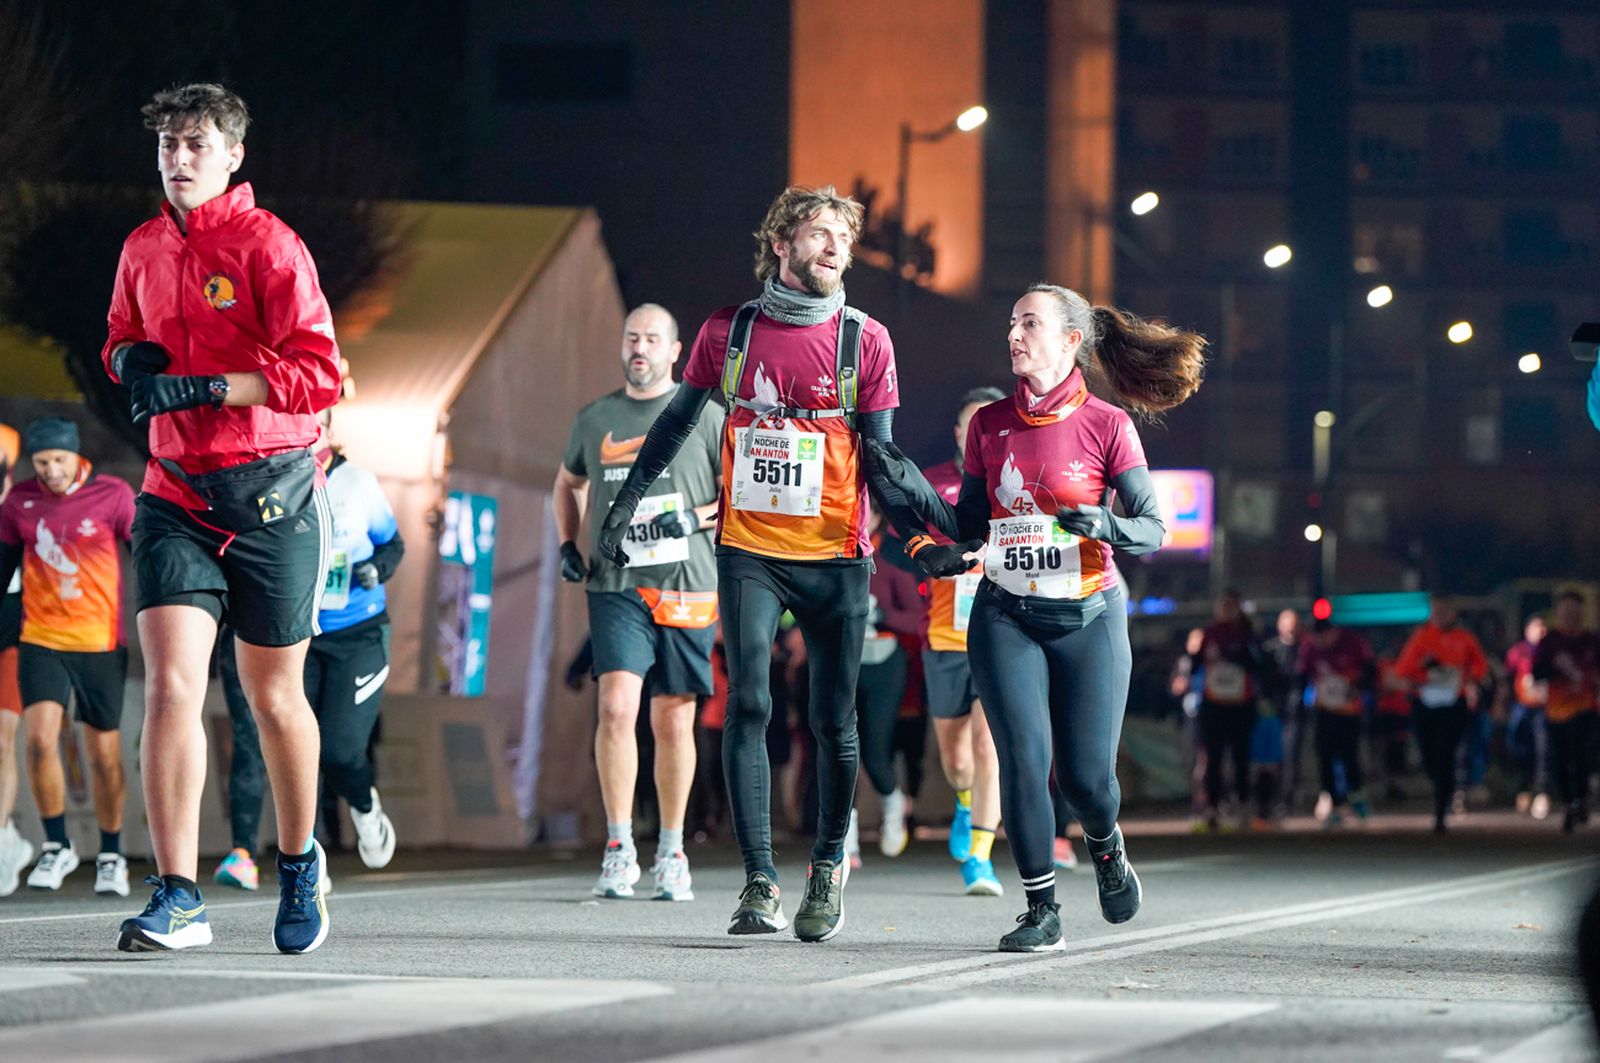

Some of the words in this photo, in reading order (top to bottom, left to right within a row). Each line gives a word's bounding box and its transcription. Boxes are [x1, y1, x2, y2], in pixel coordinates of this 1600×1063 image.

[754, 438, 779, 448] NOCHE
[780, 440, 790, 449] DE
[750, 447, 762, 457] AN
[603, 467, 630, 482] JUST
[753, 458, 802, 486] 5511
[1011, 497, 1034, 515] 43
[626, 522, 670, 543] 430
[1008, 524, 1032, 535] NOCHE
[1033, 524, 1044, 533] DE
[999, 536, 1015, 547] SAN
[1003, 545, 1062, 571] 5510
